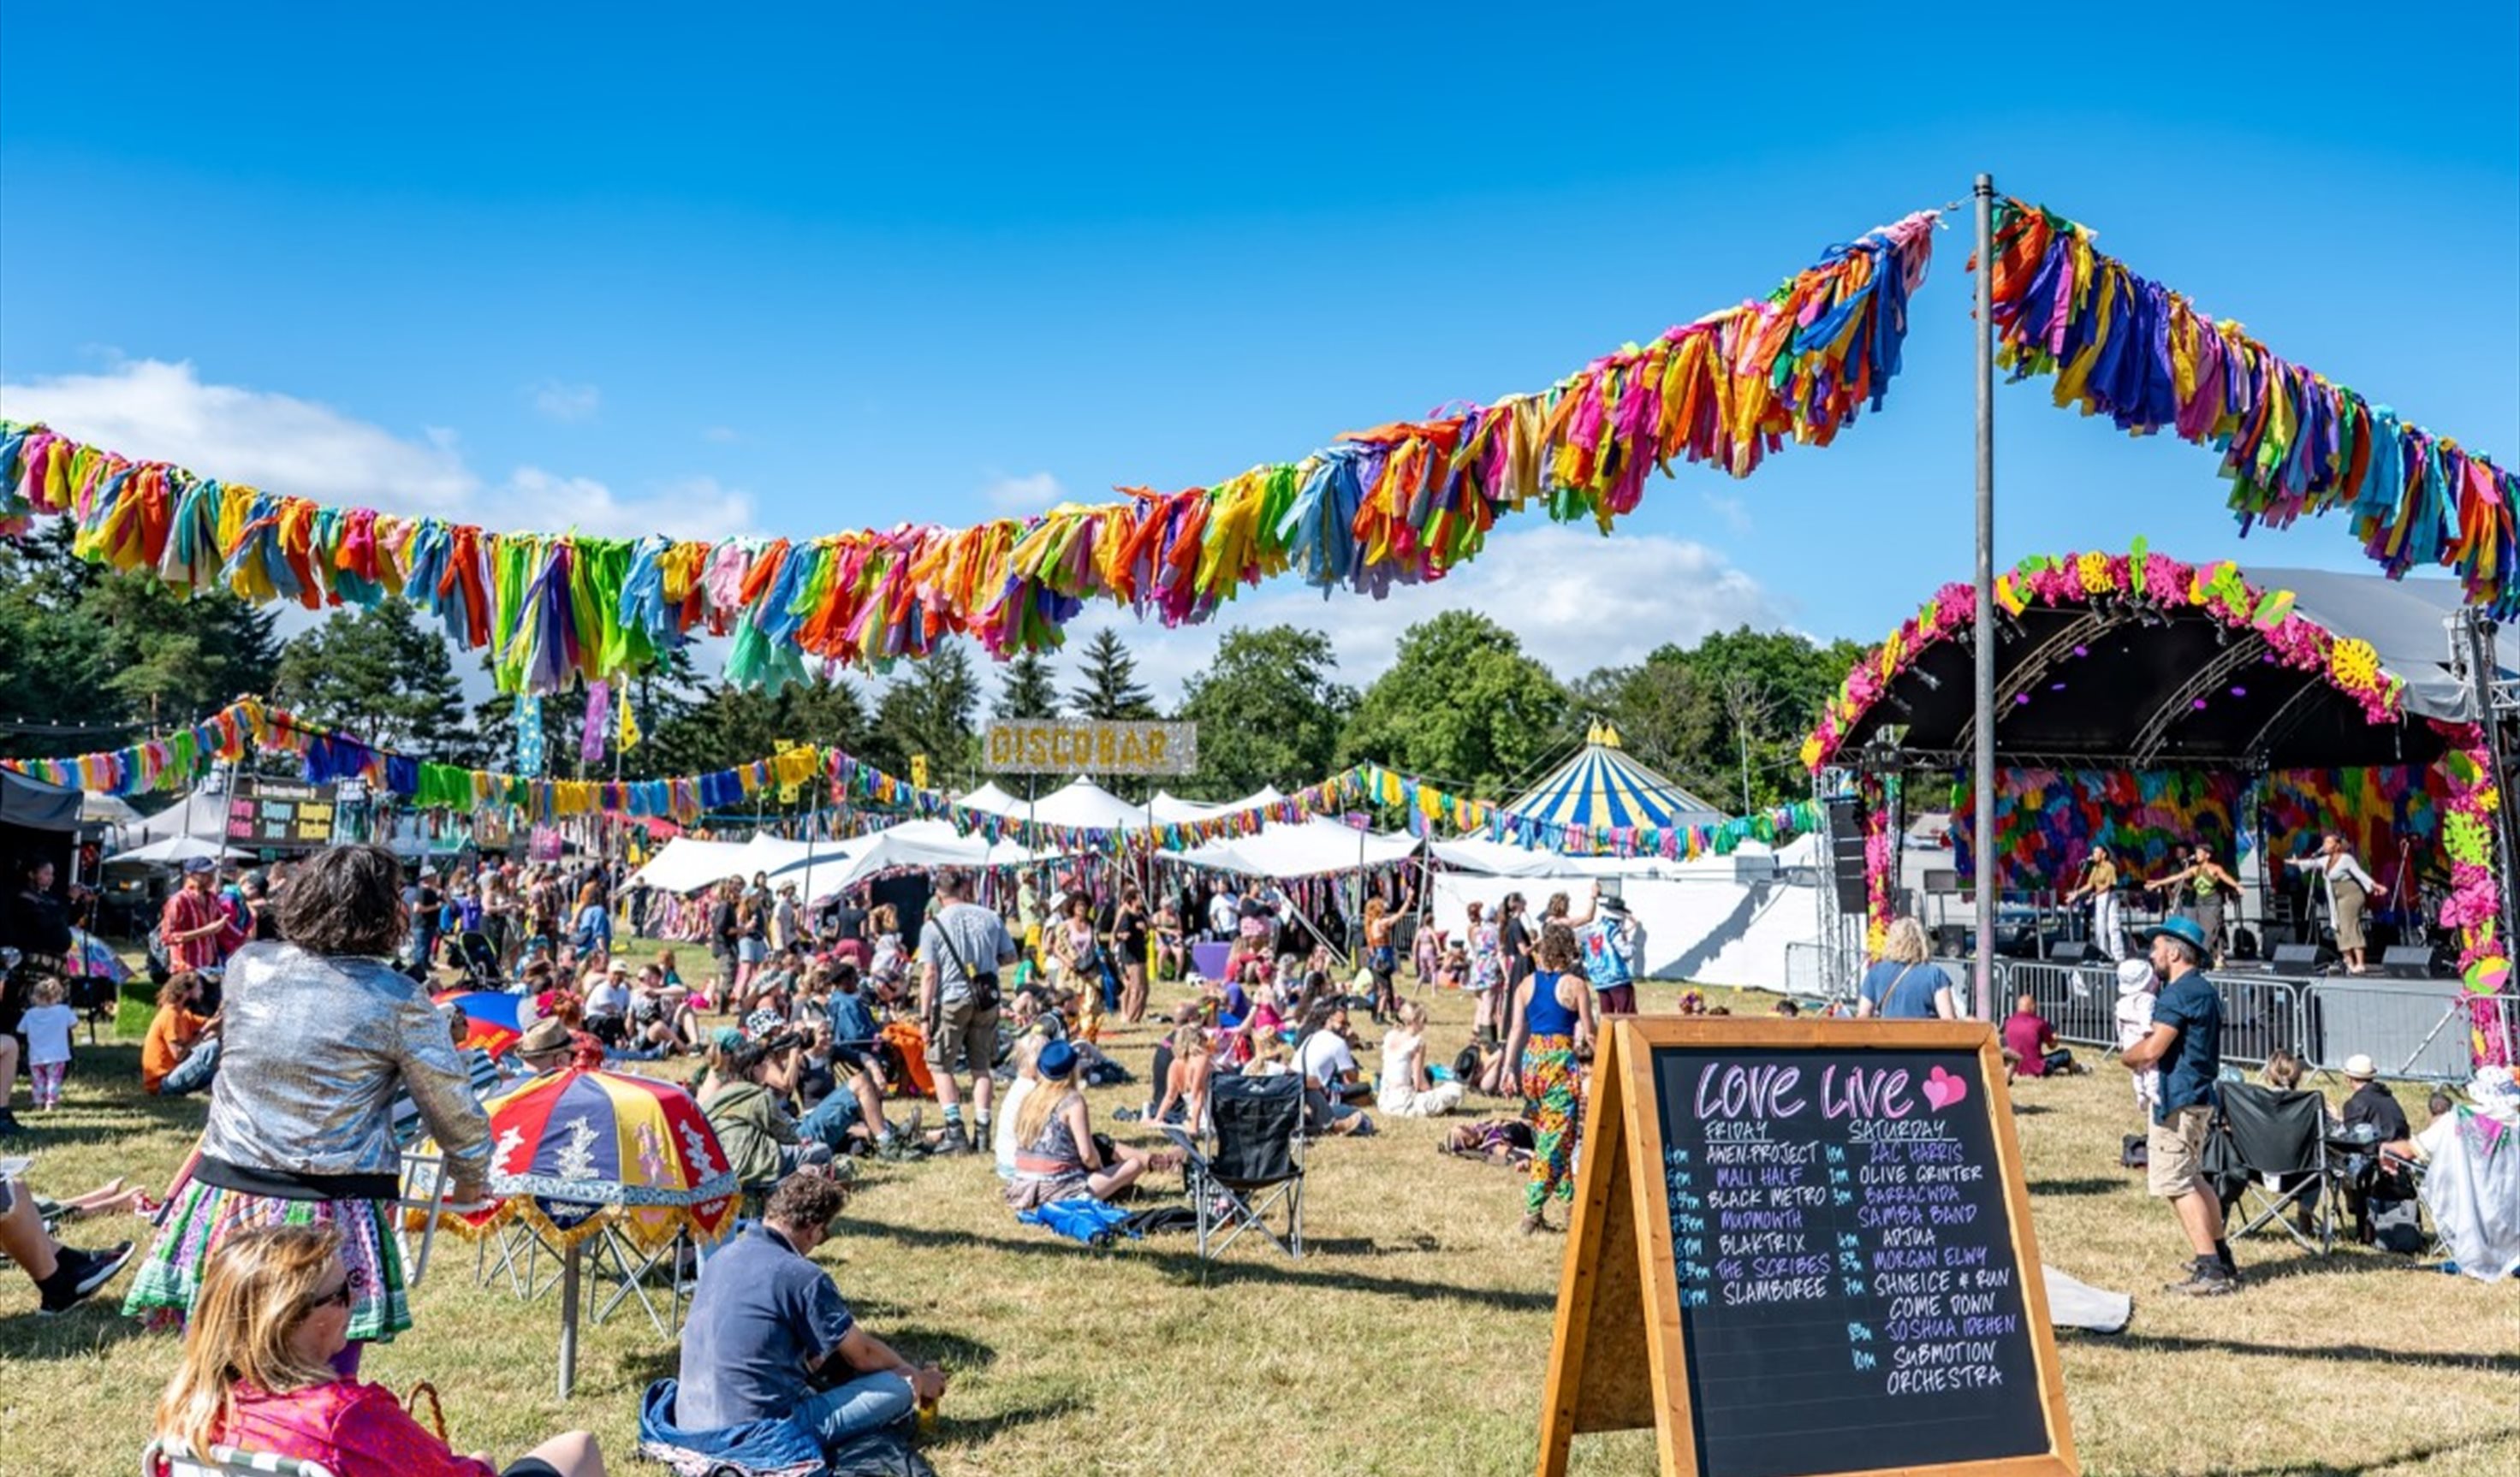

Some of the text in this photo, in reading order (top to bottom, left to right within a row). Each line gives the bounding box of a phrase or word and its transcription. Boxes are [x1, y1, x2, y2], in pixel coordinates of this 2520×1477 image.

[1704, 1119, 1769, 1141] FRIDAY
[1847, 1118, 1946, 1141] SATURDAY
[1869, 1141, 1902, 1164] ZAC
[1908, 1142, 1964, 1164] HARRIS
[1716, 1167, 1754, 1188] MALI
[1761, 1166, 1804, 1187] HALF
[1859, 1165, 1908, 1184] OLIVE
[1916, 1164, 1984, 1183] GRINTER
[1707, 1190, 1762, 1209] BLACK
[1769, 1186, 1828, 1207] METRO
[1857, 1203, 1978, 1228] SAMBA BAND
[1719, 1231, 1806, 1256] BLAKTRIX
[1882, 1225, 1937, 1248] ADJUA
[1715, 1258, 1744, 1280] THE
[1752, 1253, 1832, 1278] SCRIBES
[1872, 1248, 1938, 1271] MORGAN
[1943, 1245, 1988, 1266] ELWY
[1722, 1275, 1828, 1306] SLAMBOREE
[1873, 1270, 1952, 1297] SHNEICE
[1975, 1267, 2011, 1288] RUN
[1888, 1292, 1997, 1320] COME DOWN
[1885, 1317, 1958, 1342] JOSHUA
[1963, 1314, 2018, 1337] IDEHEN
[1887, 1364, 2004, 1396] ORCHESTRA
